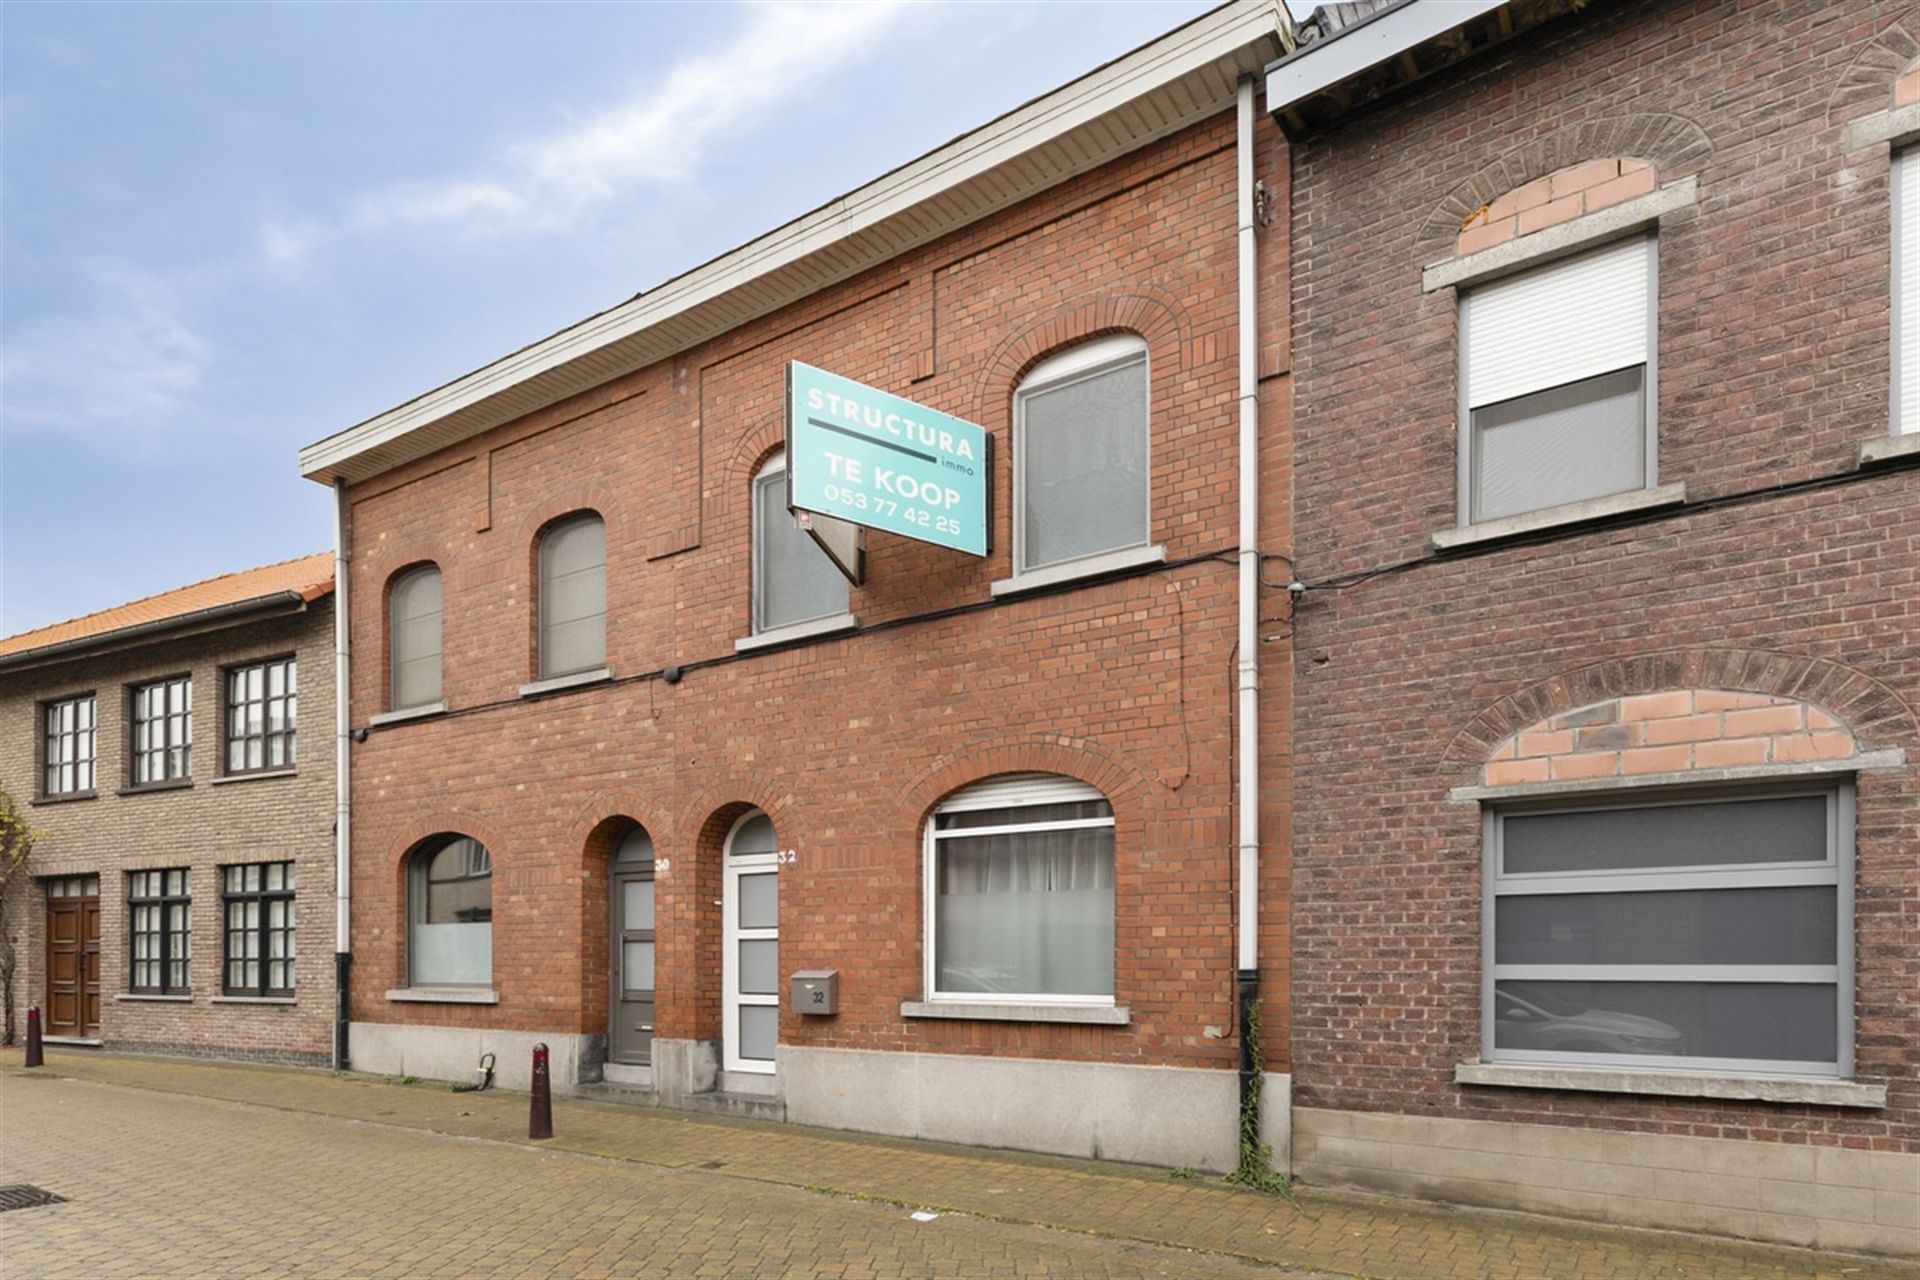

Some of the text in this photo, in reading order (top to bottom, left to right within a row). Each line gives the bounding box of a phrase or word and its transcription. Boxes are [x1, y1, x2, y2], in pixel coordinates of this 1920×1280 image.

[808, 388, 973, 460] STRUCTURA
[824, 452, 961, 510] TE KOOP
[941, 456, 974, 476] immo
[824, 484, 961, 535] 053 77 42 25
[778, 850, 796, 863] 32
[813, 991, 824, 1003] 32
